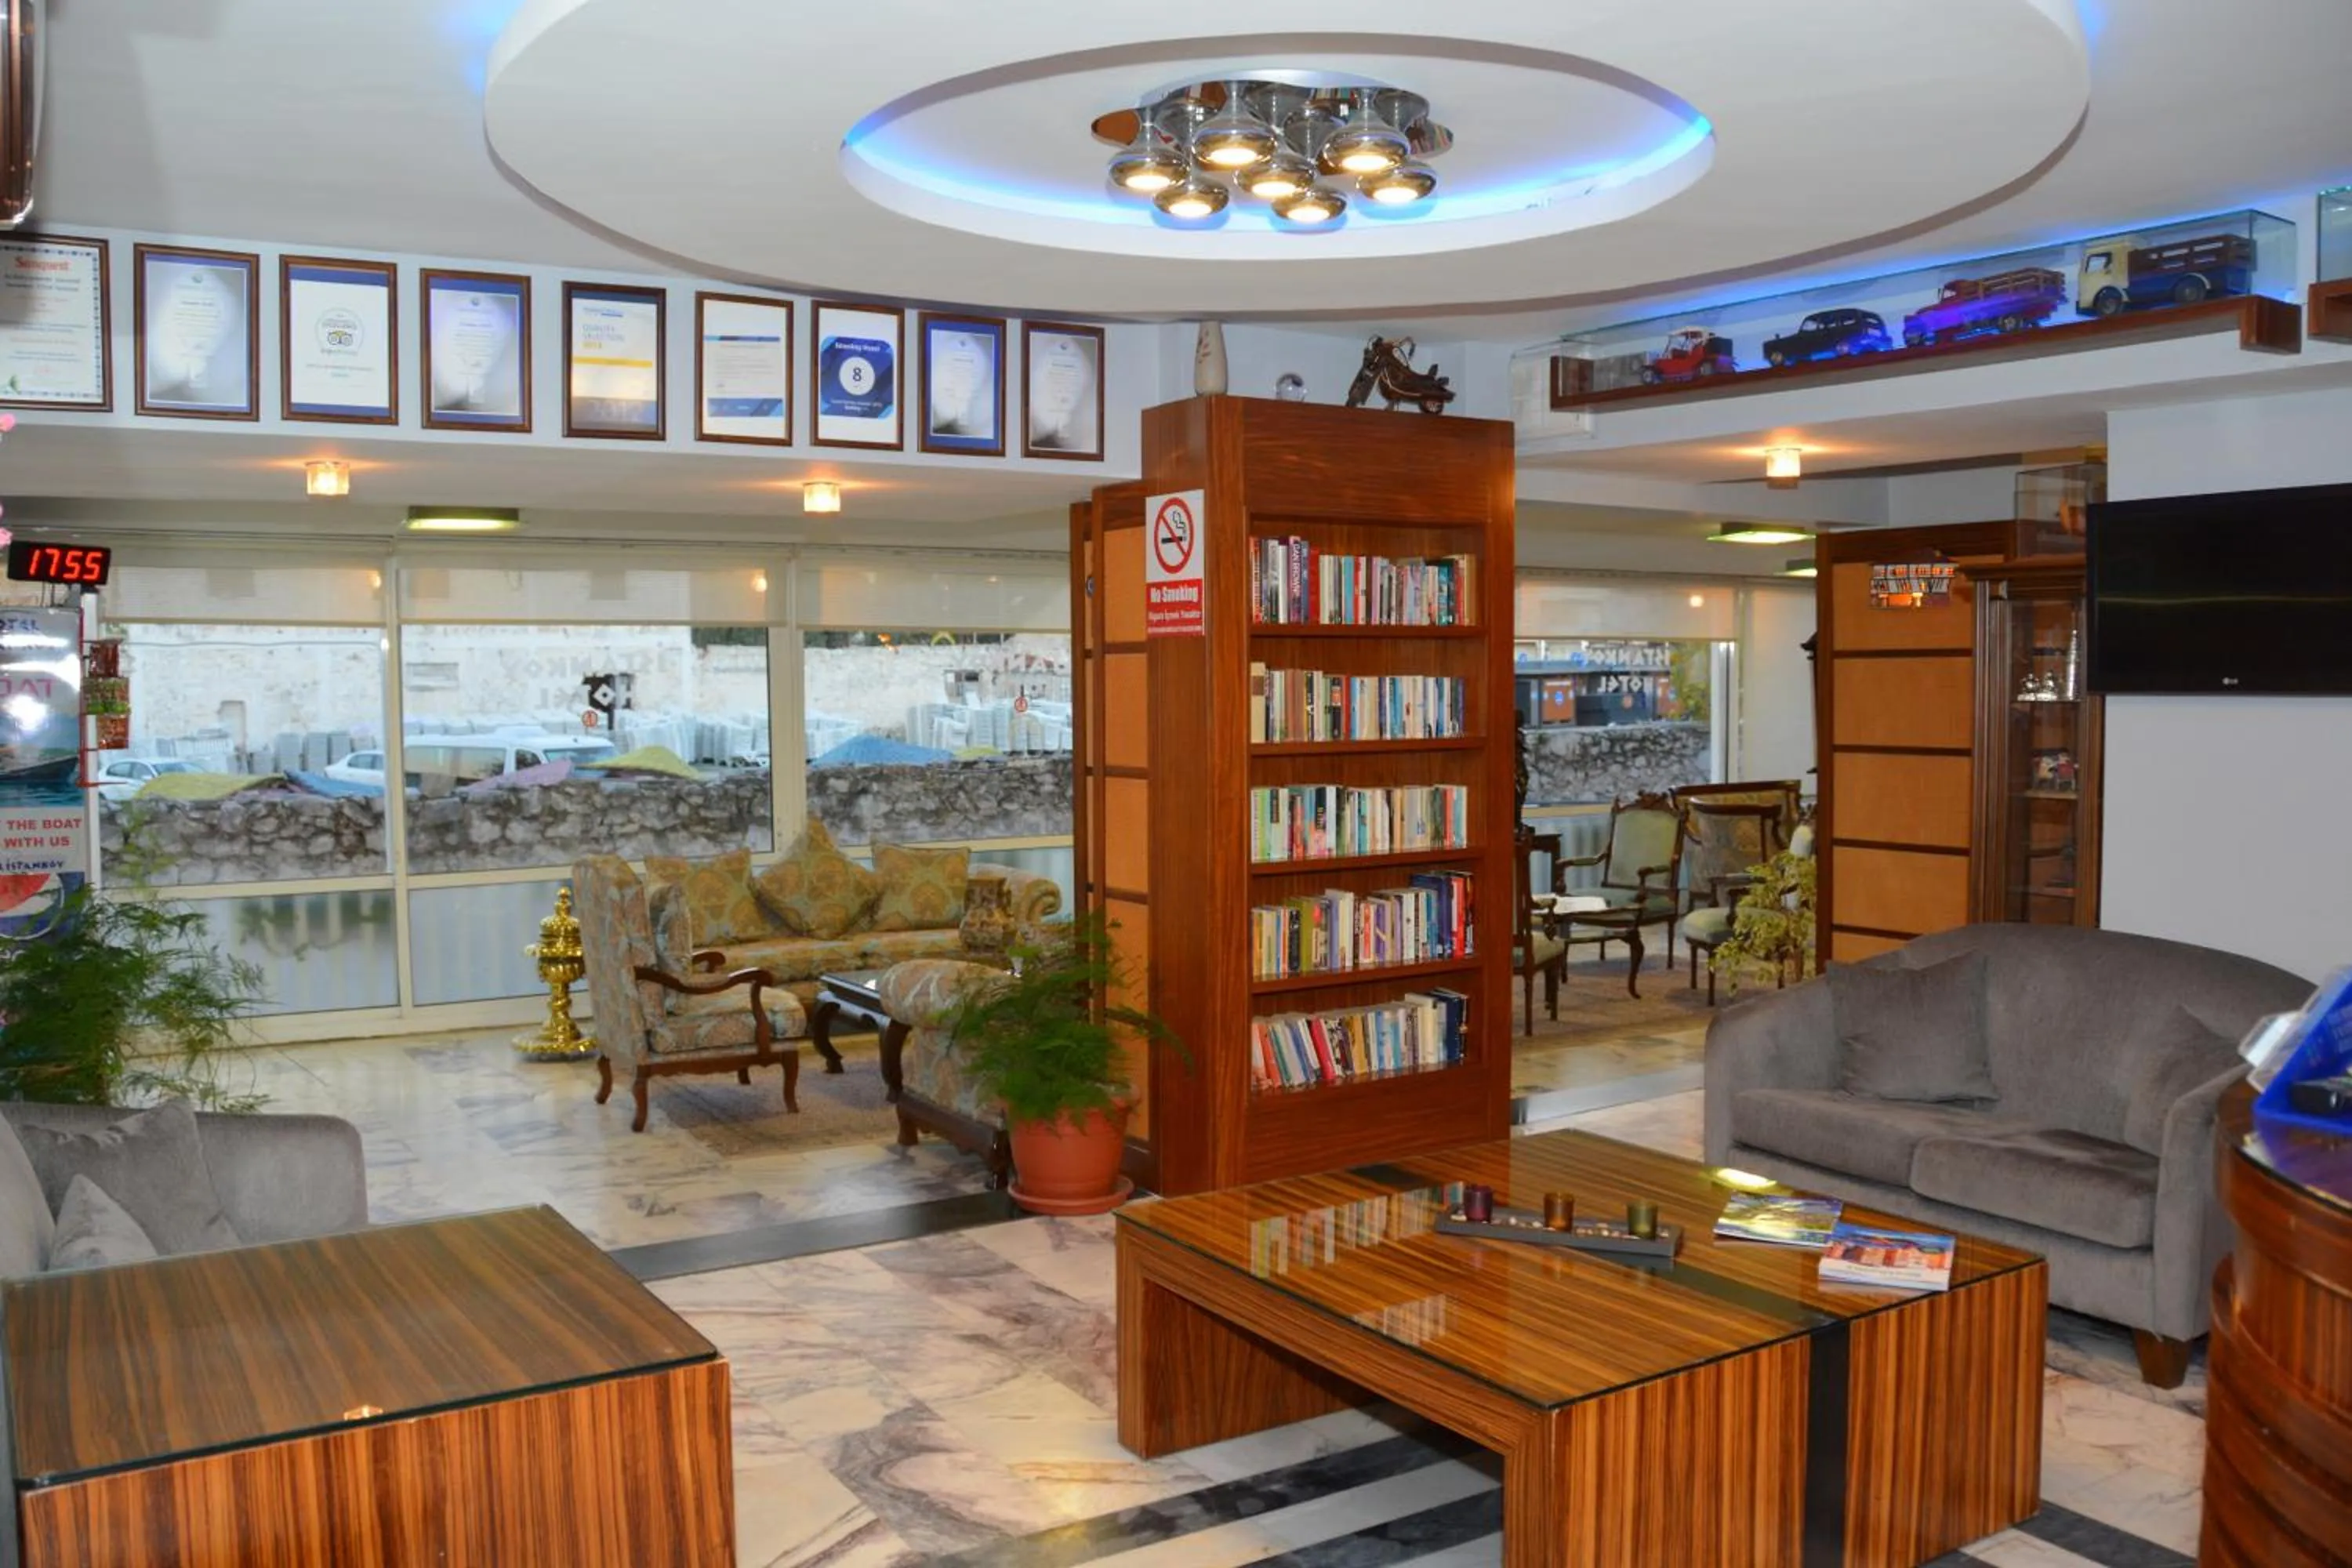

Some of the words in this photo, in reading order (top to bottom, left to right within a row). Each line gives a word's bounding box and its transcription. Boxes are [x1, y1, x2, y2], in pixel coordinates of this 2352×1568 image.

[852, 367, 862, 382] 8
[7, 819, 37, 830] THE
[42, 818, 82, 829] BOAT
[4, 837, 44, 848] WITH
[50, 836, 70, 847] US
